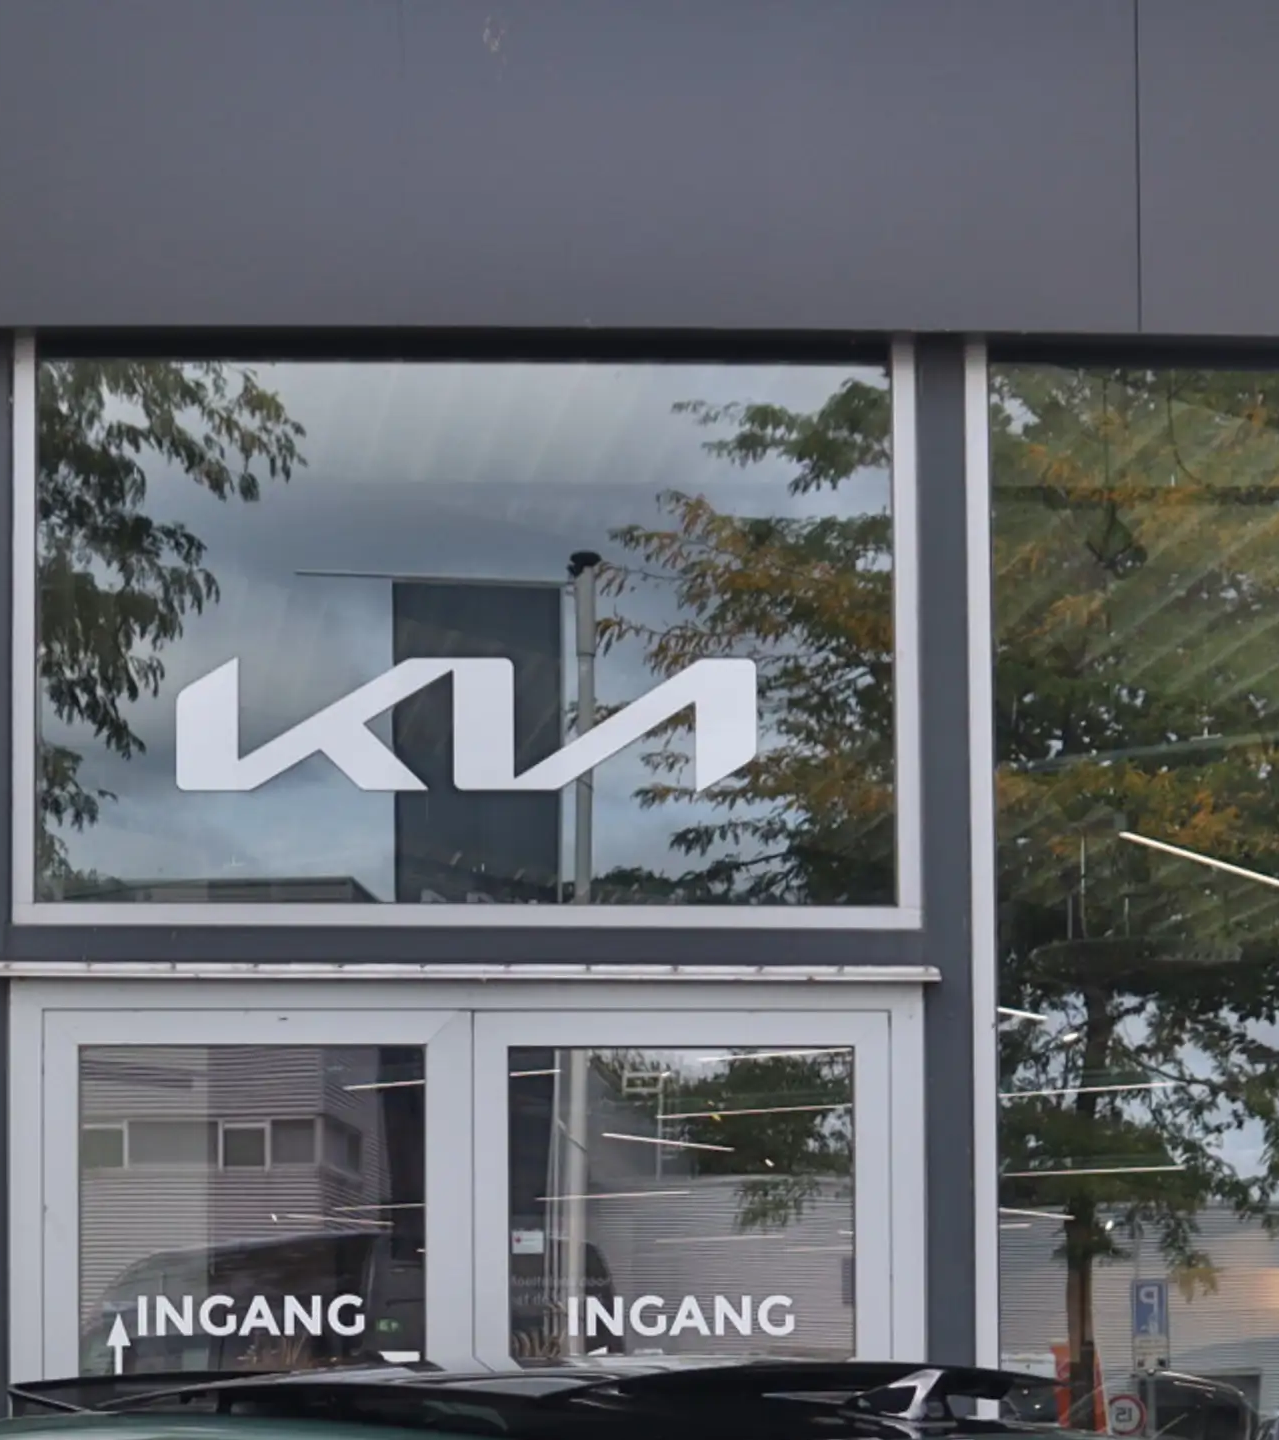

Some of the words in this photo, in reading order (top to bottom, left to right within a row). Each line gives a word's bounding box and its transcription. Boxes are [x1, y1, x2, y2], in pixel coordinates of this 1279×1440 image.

[175, 657, 758, 793] KIA
[137, 1294, 365, 1337] INGANG
[567, 1294, 796, 1337] INGANG
